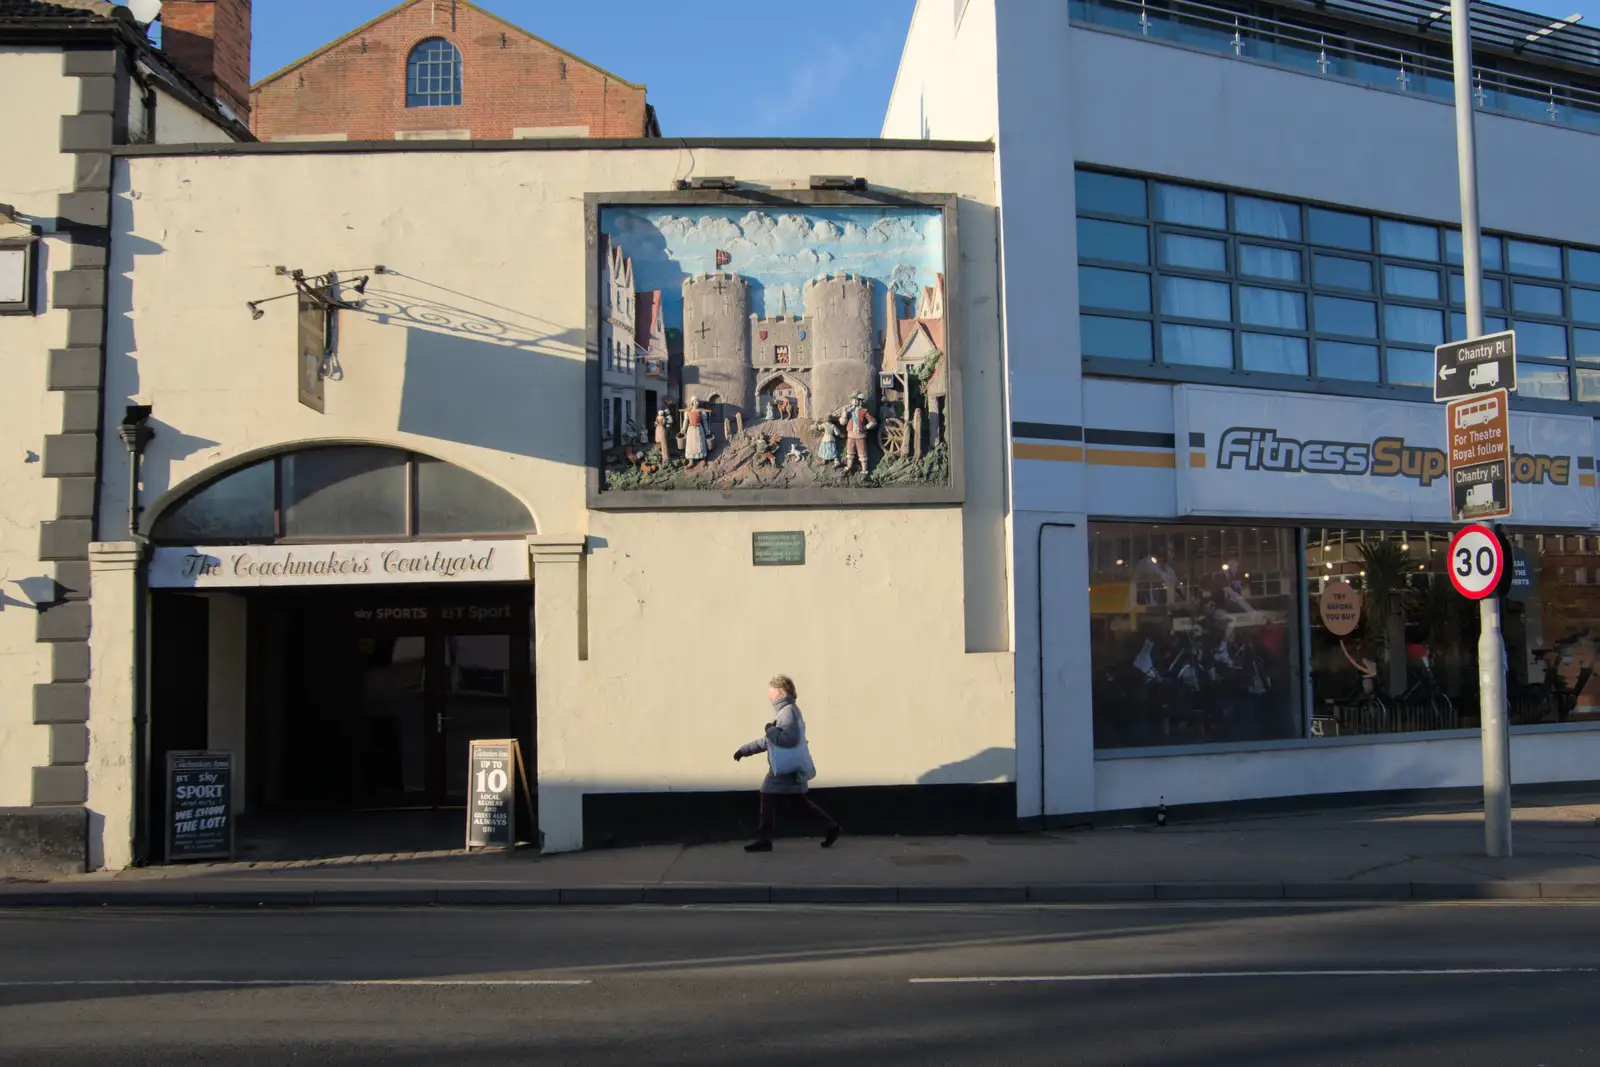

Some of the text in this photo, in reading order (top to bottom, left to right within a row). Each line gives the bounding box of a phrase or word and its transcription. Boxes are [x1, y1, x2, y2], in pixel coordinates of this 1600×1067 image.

[1458, 340, 1506, 361] Chantry Pl
[1454, 427, 1501, 446] For Theatre
[1453, 441, 1504, 461] Royal follow
[1456, 464, 1500, 484] Chantry Pl
[181, 547, 495, 579] The Coachmakers Courtyard
[1456, 546, 1495, 577] 30
[354, 607, 428, 620] sky SPORTS
[468, 604, 512, 621] Sport
[480, 760, 502, 769] UP TO
[175, 772, 218, 783] BT sky
[475, 768, 508, 793] 10
[176, 785, 225, 799] SPORT
[175, 804, 226, 820] WE SHOW
[175, 816, 226, 833] THE LOT!
